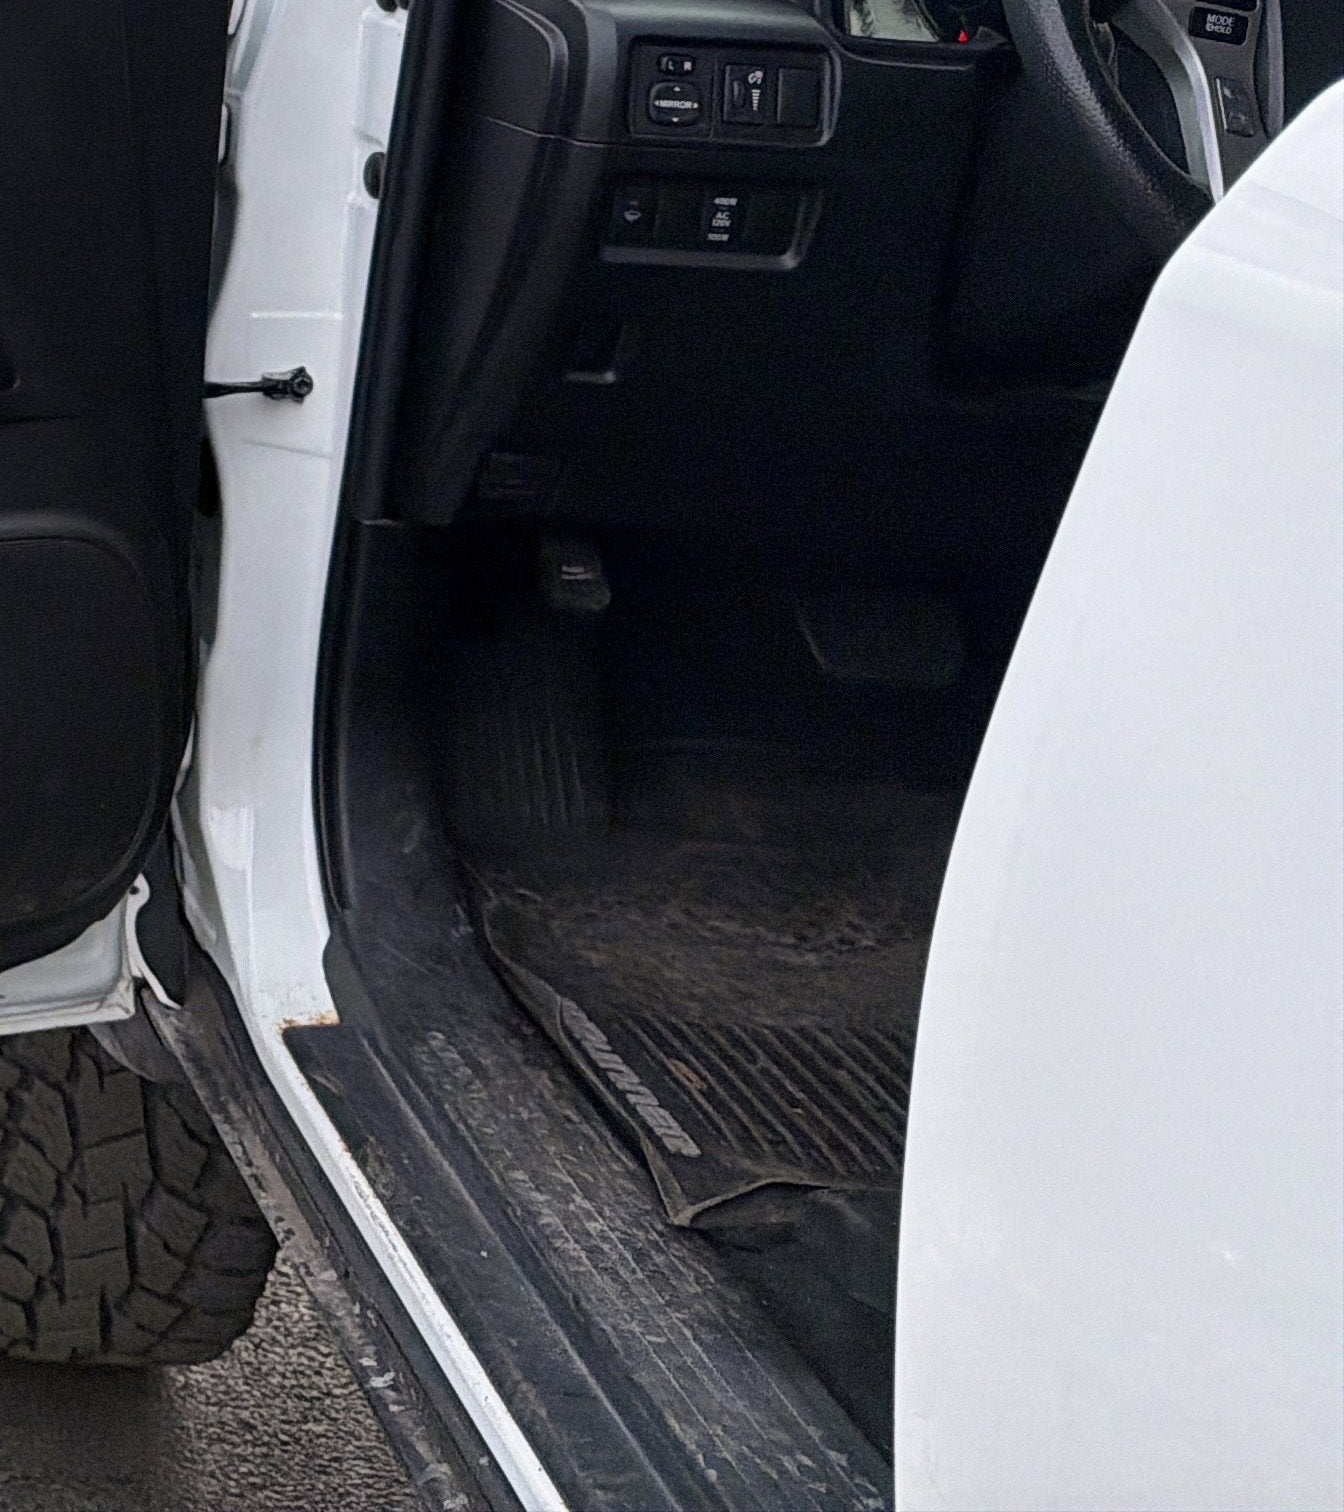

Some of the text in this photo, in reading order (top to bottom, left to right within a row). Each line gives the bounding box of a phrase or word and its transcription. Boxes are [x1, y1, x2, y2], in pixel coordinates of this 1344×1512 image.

[1207, 14, 1235, 26] MODE
[659, 99, 693, 109] MIRROR
[715, 211, 731, 220] AC
